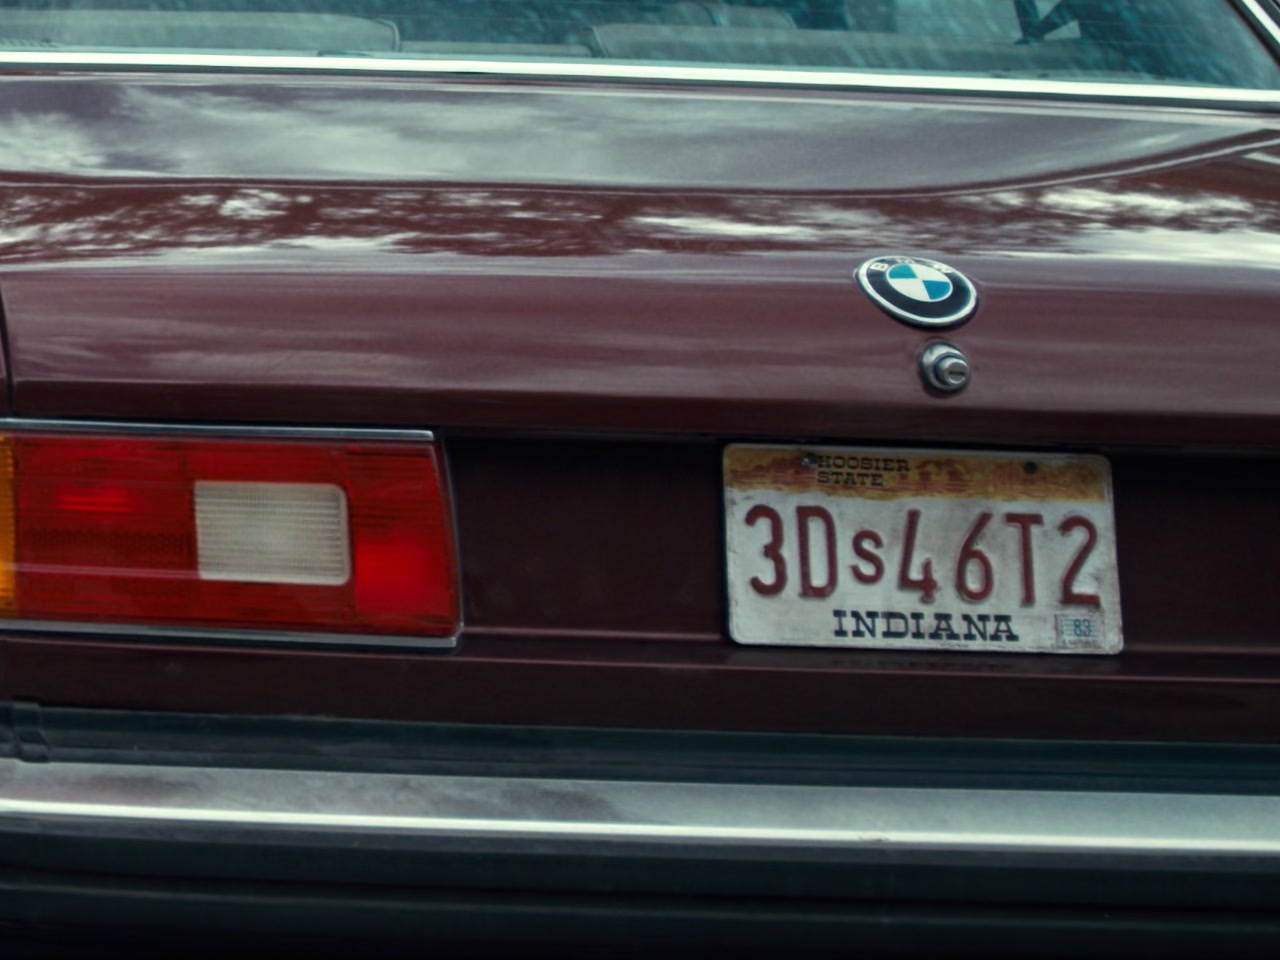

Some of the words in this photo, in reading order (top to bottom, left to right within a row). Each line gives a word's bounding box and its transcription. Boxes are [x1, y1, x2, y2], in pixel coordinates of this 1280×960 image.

[817, 455, 911, 472] HOOSIER
[817, 470, 884, 487] STATE
[832, 608, 1019, 642] INDIANA
